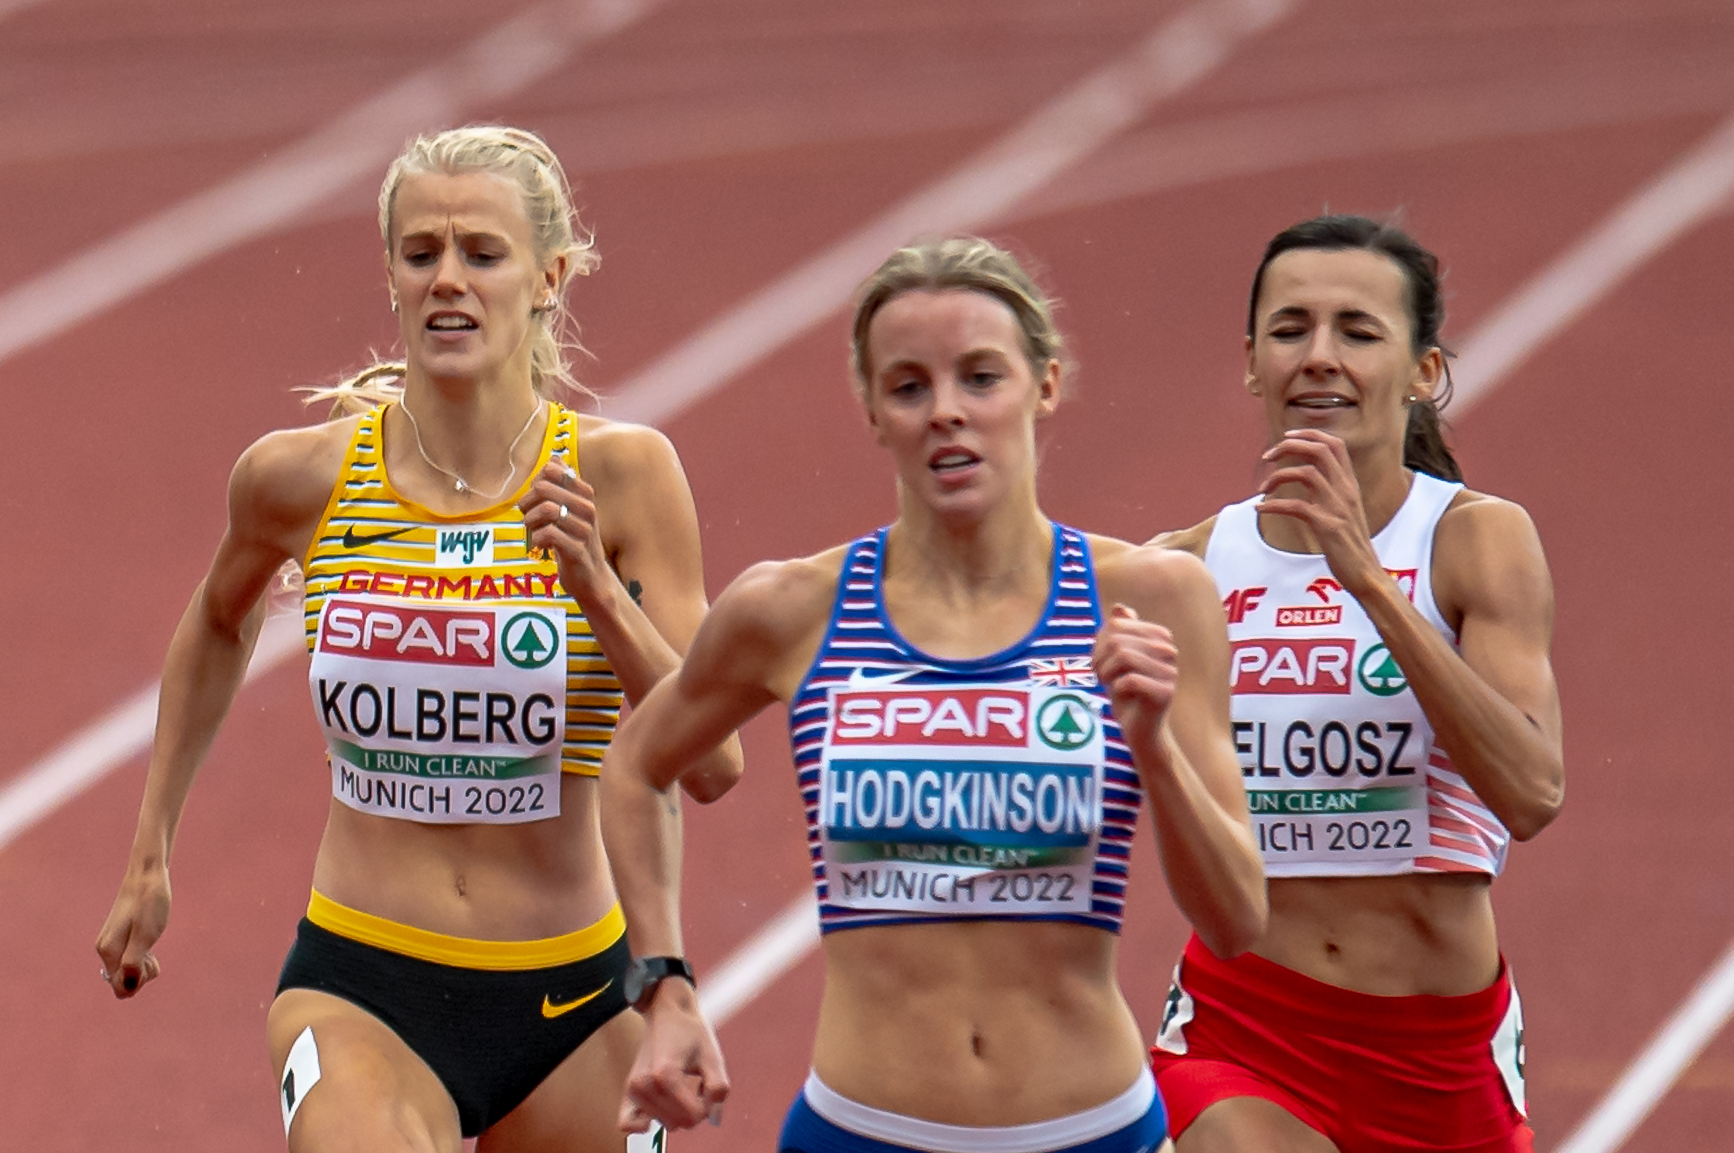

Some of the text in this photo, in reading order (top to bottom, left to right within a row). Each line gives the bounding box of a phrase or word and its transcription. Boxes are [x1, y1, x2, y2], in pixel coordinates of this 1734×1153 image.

[339, 569, 559, 600] GERMANY
[326, 608, 490, 660] SPAR
[1279, 608, 1339, 624] ORLEN
[1231, 646, 1348, 686] PAR
[318, 678, 556, 746] KOLBERG
[836, 697, 1024, 739] SPAR
[364, 752, 369, 767] I
[377, 753, 419, 773] RUN
[1231, 720, 1416, 778] ELGOSZ
[341, 766, 544, 814] MUNICH 2022
[830, 770, 1096, 834] HODGKINSON
[1249, 792, 1279, 811] UN
[1259, 819, 1413, 852] ICH 2022
[841, 870, 1074, 902] MUNICH 2022
